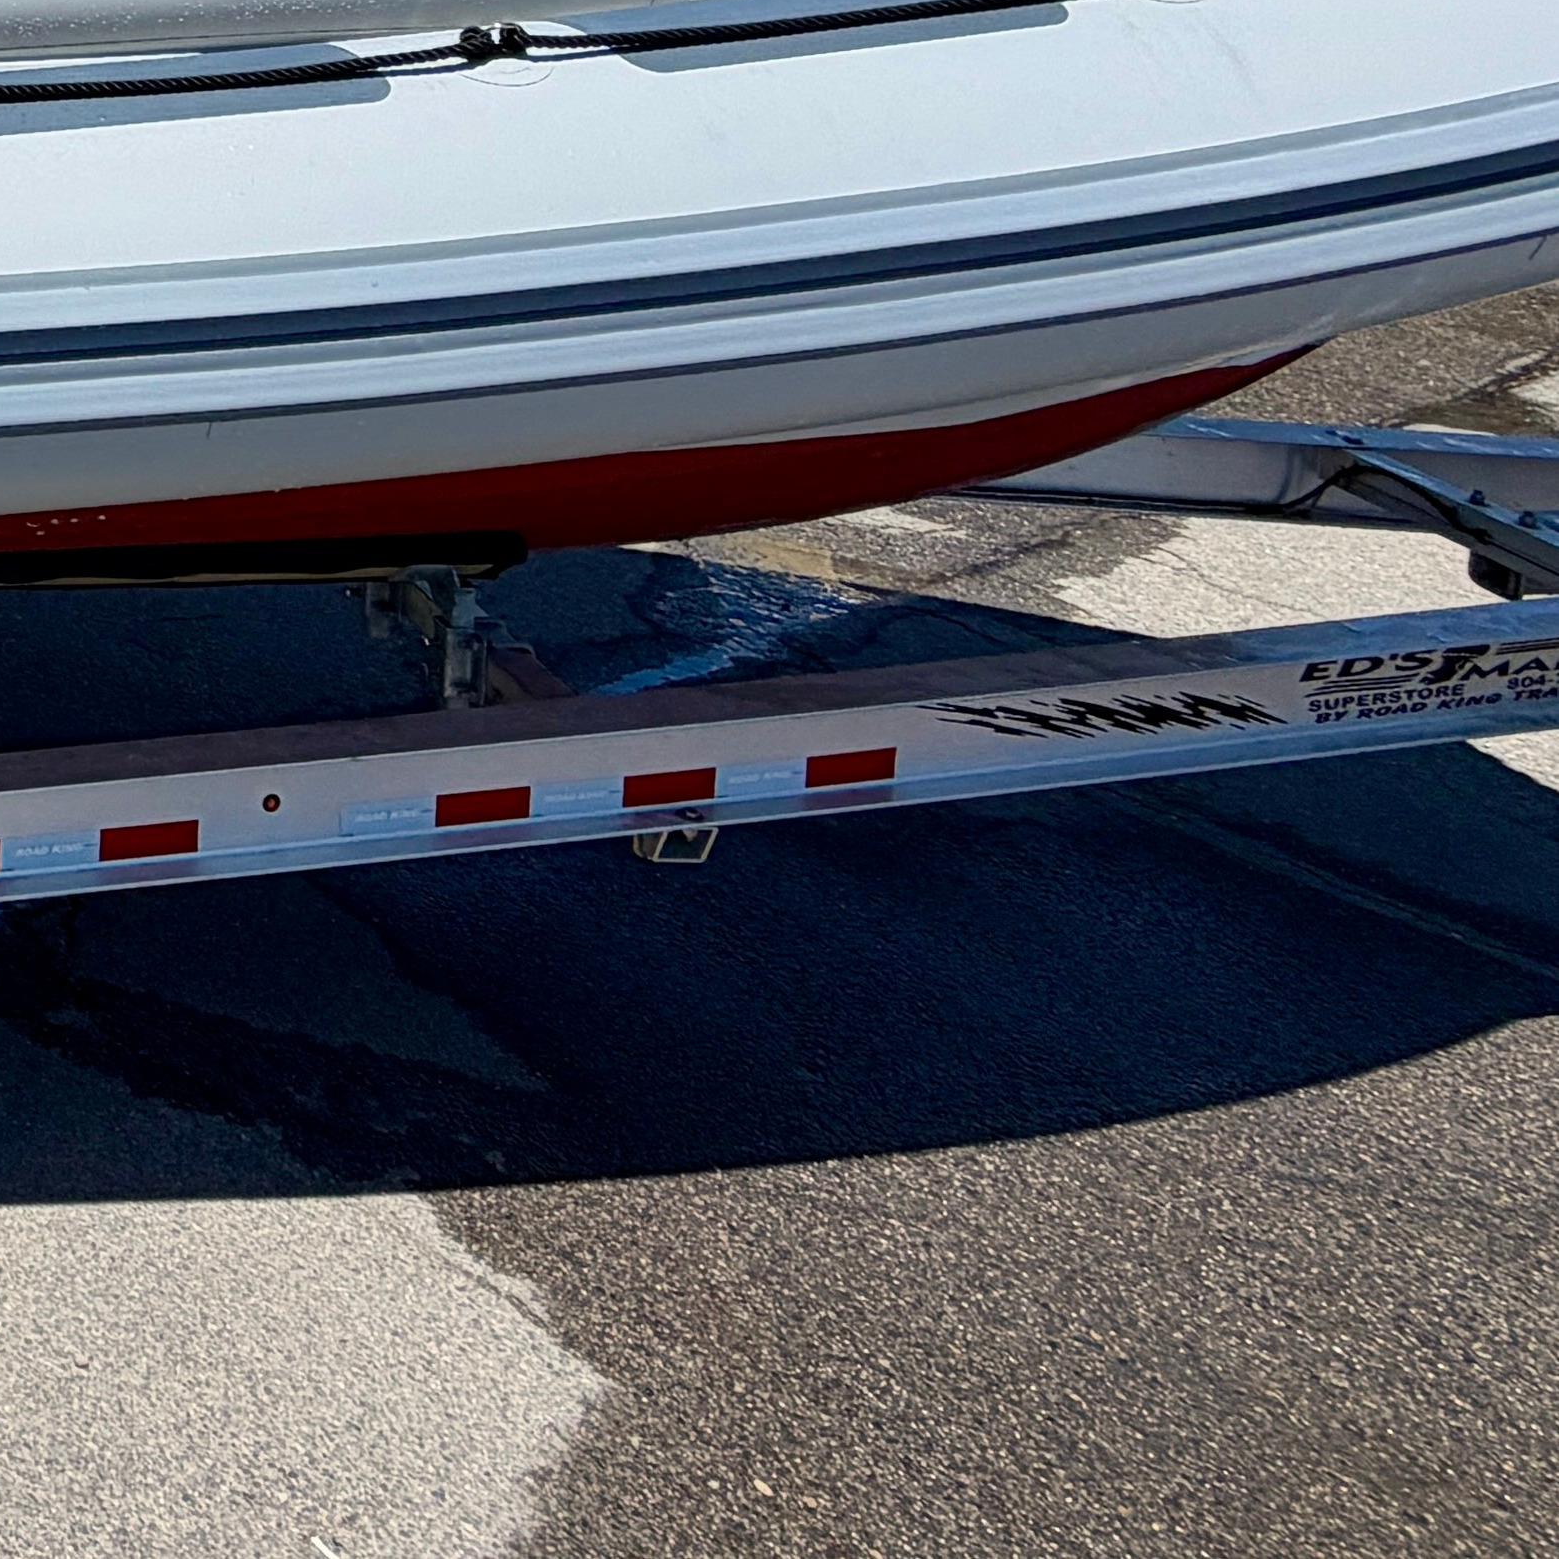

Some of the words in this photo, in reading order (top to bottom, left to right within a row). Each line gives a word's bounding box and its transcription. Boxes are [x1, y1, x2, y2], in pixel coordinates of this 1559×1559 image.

[1299, 649, 1439, 683] ED'S
[1460, 656, 1559, 682] MA
[1308, 683, 1465, 713] SUPERSTORE
[1315, 711, 1348, 724] BY
[1356, 701, 1428, 720] ROAD
[1437, 692, 1503, 710] KING
